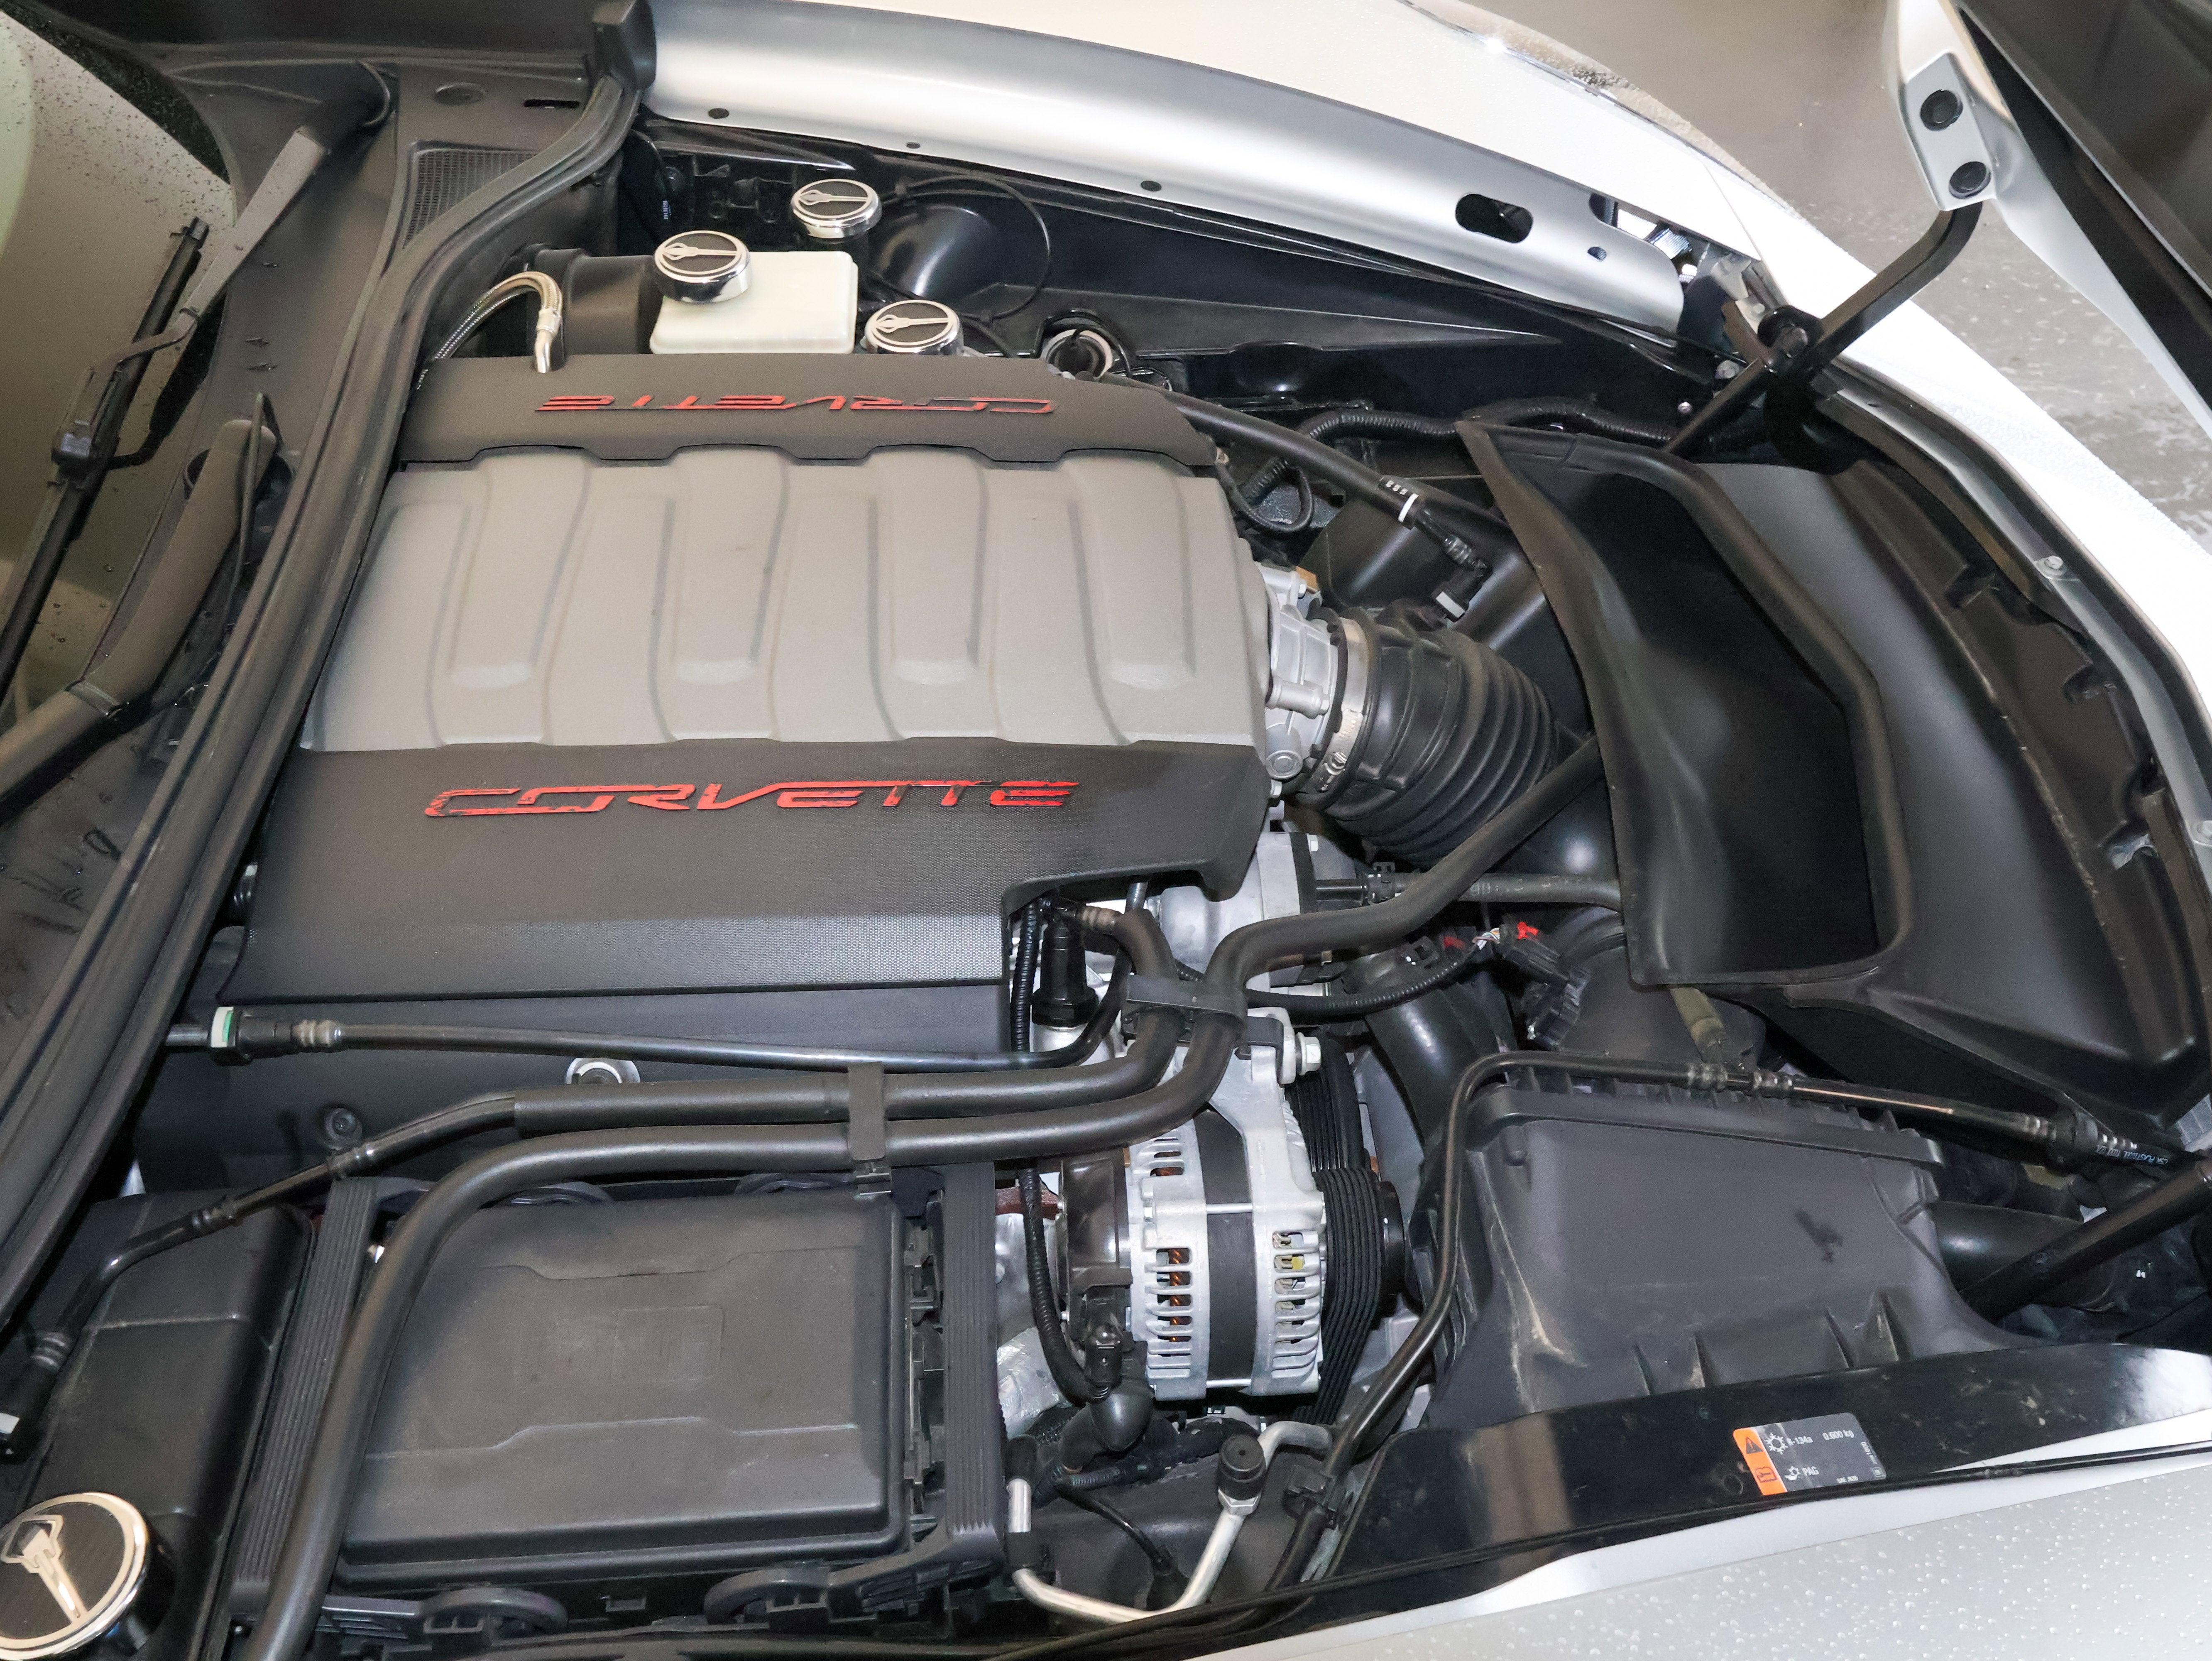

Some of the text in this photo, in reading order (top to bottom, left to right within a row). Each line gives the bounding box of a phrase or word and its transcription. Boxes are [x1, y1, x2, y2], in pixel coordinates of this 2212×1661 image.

[535, 395, 1059, 414] CORVETTE
[425, 780, 1079, 817] CORVETTE
[1786, 1429, 1855, 1446] R-134a 0.600 kg
[1802, 1466, 1819, 1476] PAG
